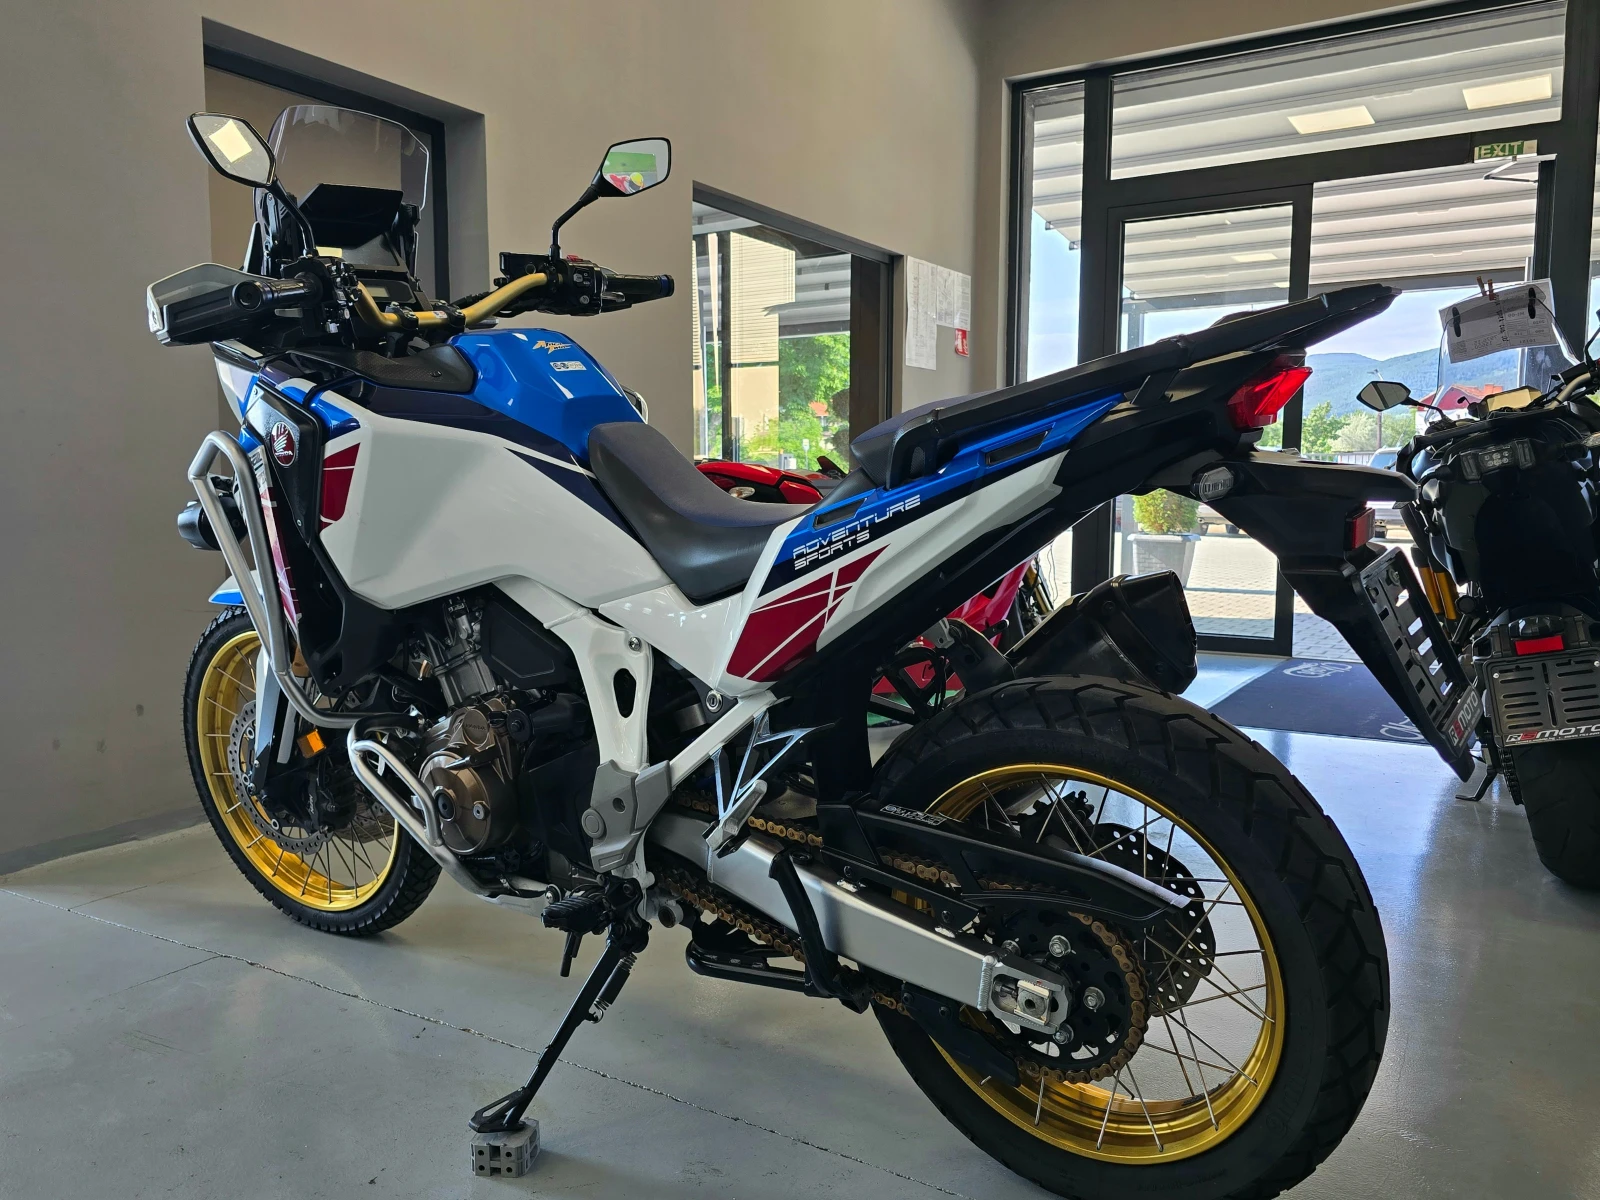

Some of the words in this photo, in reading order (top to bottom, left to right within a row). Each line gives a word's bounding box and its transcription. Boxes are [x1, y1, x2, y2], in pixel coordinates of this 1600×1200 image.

[1480, 141, 1521, 158] EXIT
[792, 494, 921, 559] ADVENTURE
[794, 529, 870, 571] SPORTS
